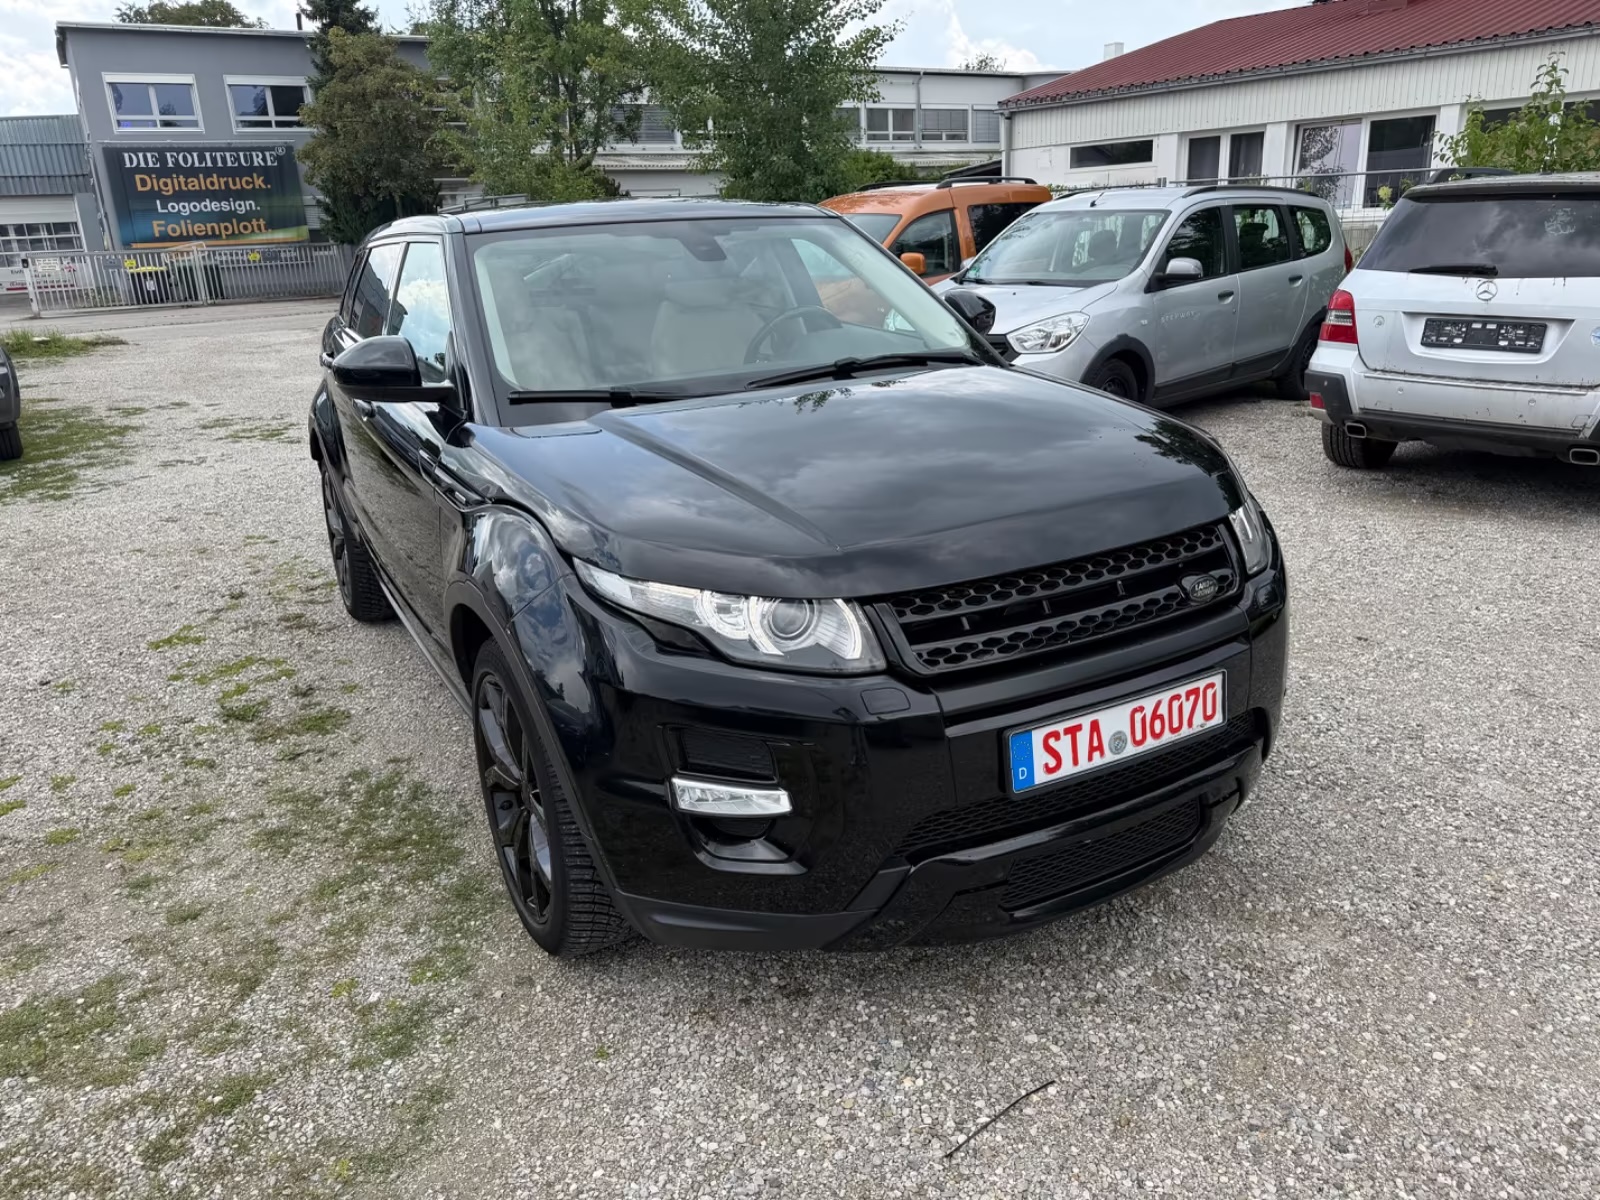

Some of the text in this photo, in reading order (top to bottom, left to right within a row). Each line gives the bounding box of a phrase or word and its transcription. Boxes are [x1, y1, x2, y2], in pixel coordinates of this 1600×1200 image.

[123, 152, 161, 168] DIE
[134, 173, 271, 195] Digitaldruck.
[156, 198, 261, 215] Logodesign.
[152, 218, 272, 239] Folienplott.
[1042, 682, 1217, 775] STA 06070
[1018, 766, 1028, 780] D
